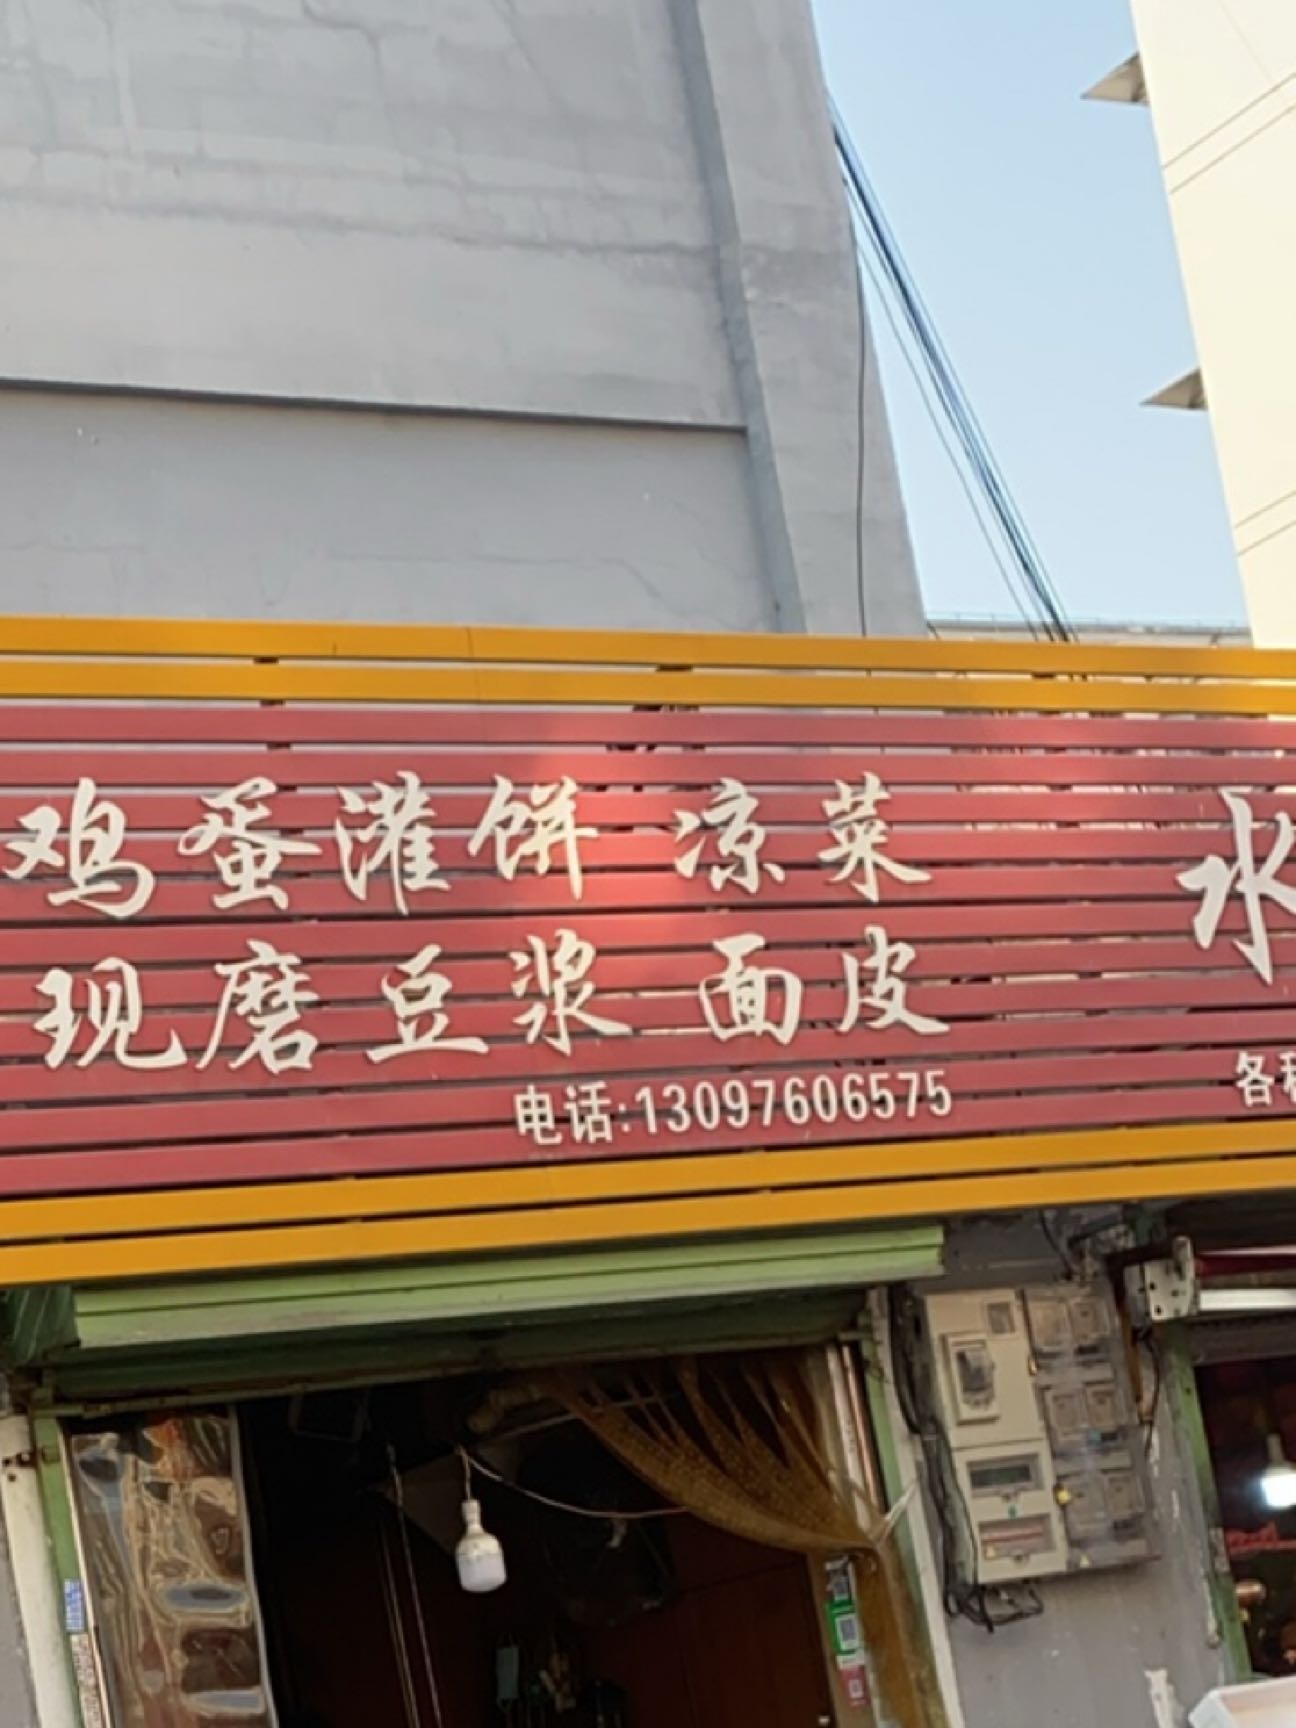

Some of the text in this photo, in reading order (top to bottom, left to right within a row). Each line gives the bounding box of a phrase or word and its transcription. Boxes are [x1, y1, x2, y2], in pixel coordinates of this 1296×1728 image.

[2, 770, 932, 918] 鸡蛋灌饼 凉菜
[1176, 786, 1296, 986] 水
[30, 925, 951, 1076] 现磨豆浆 面皮
